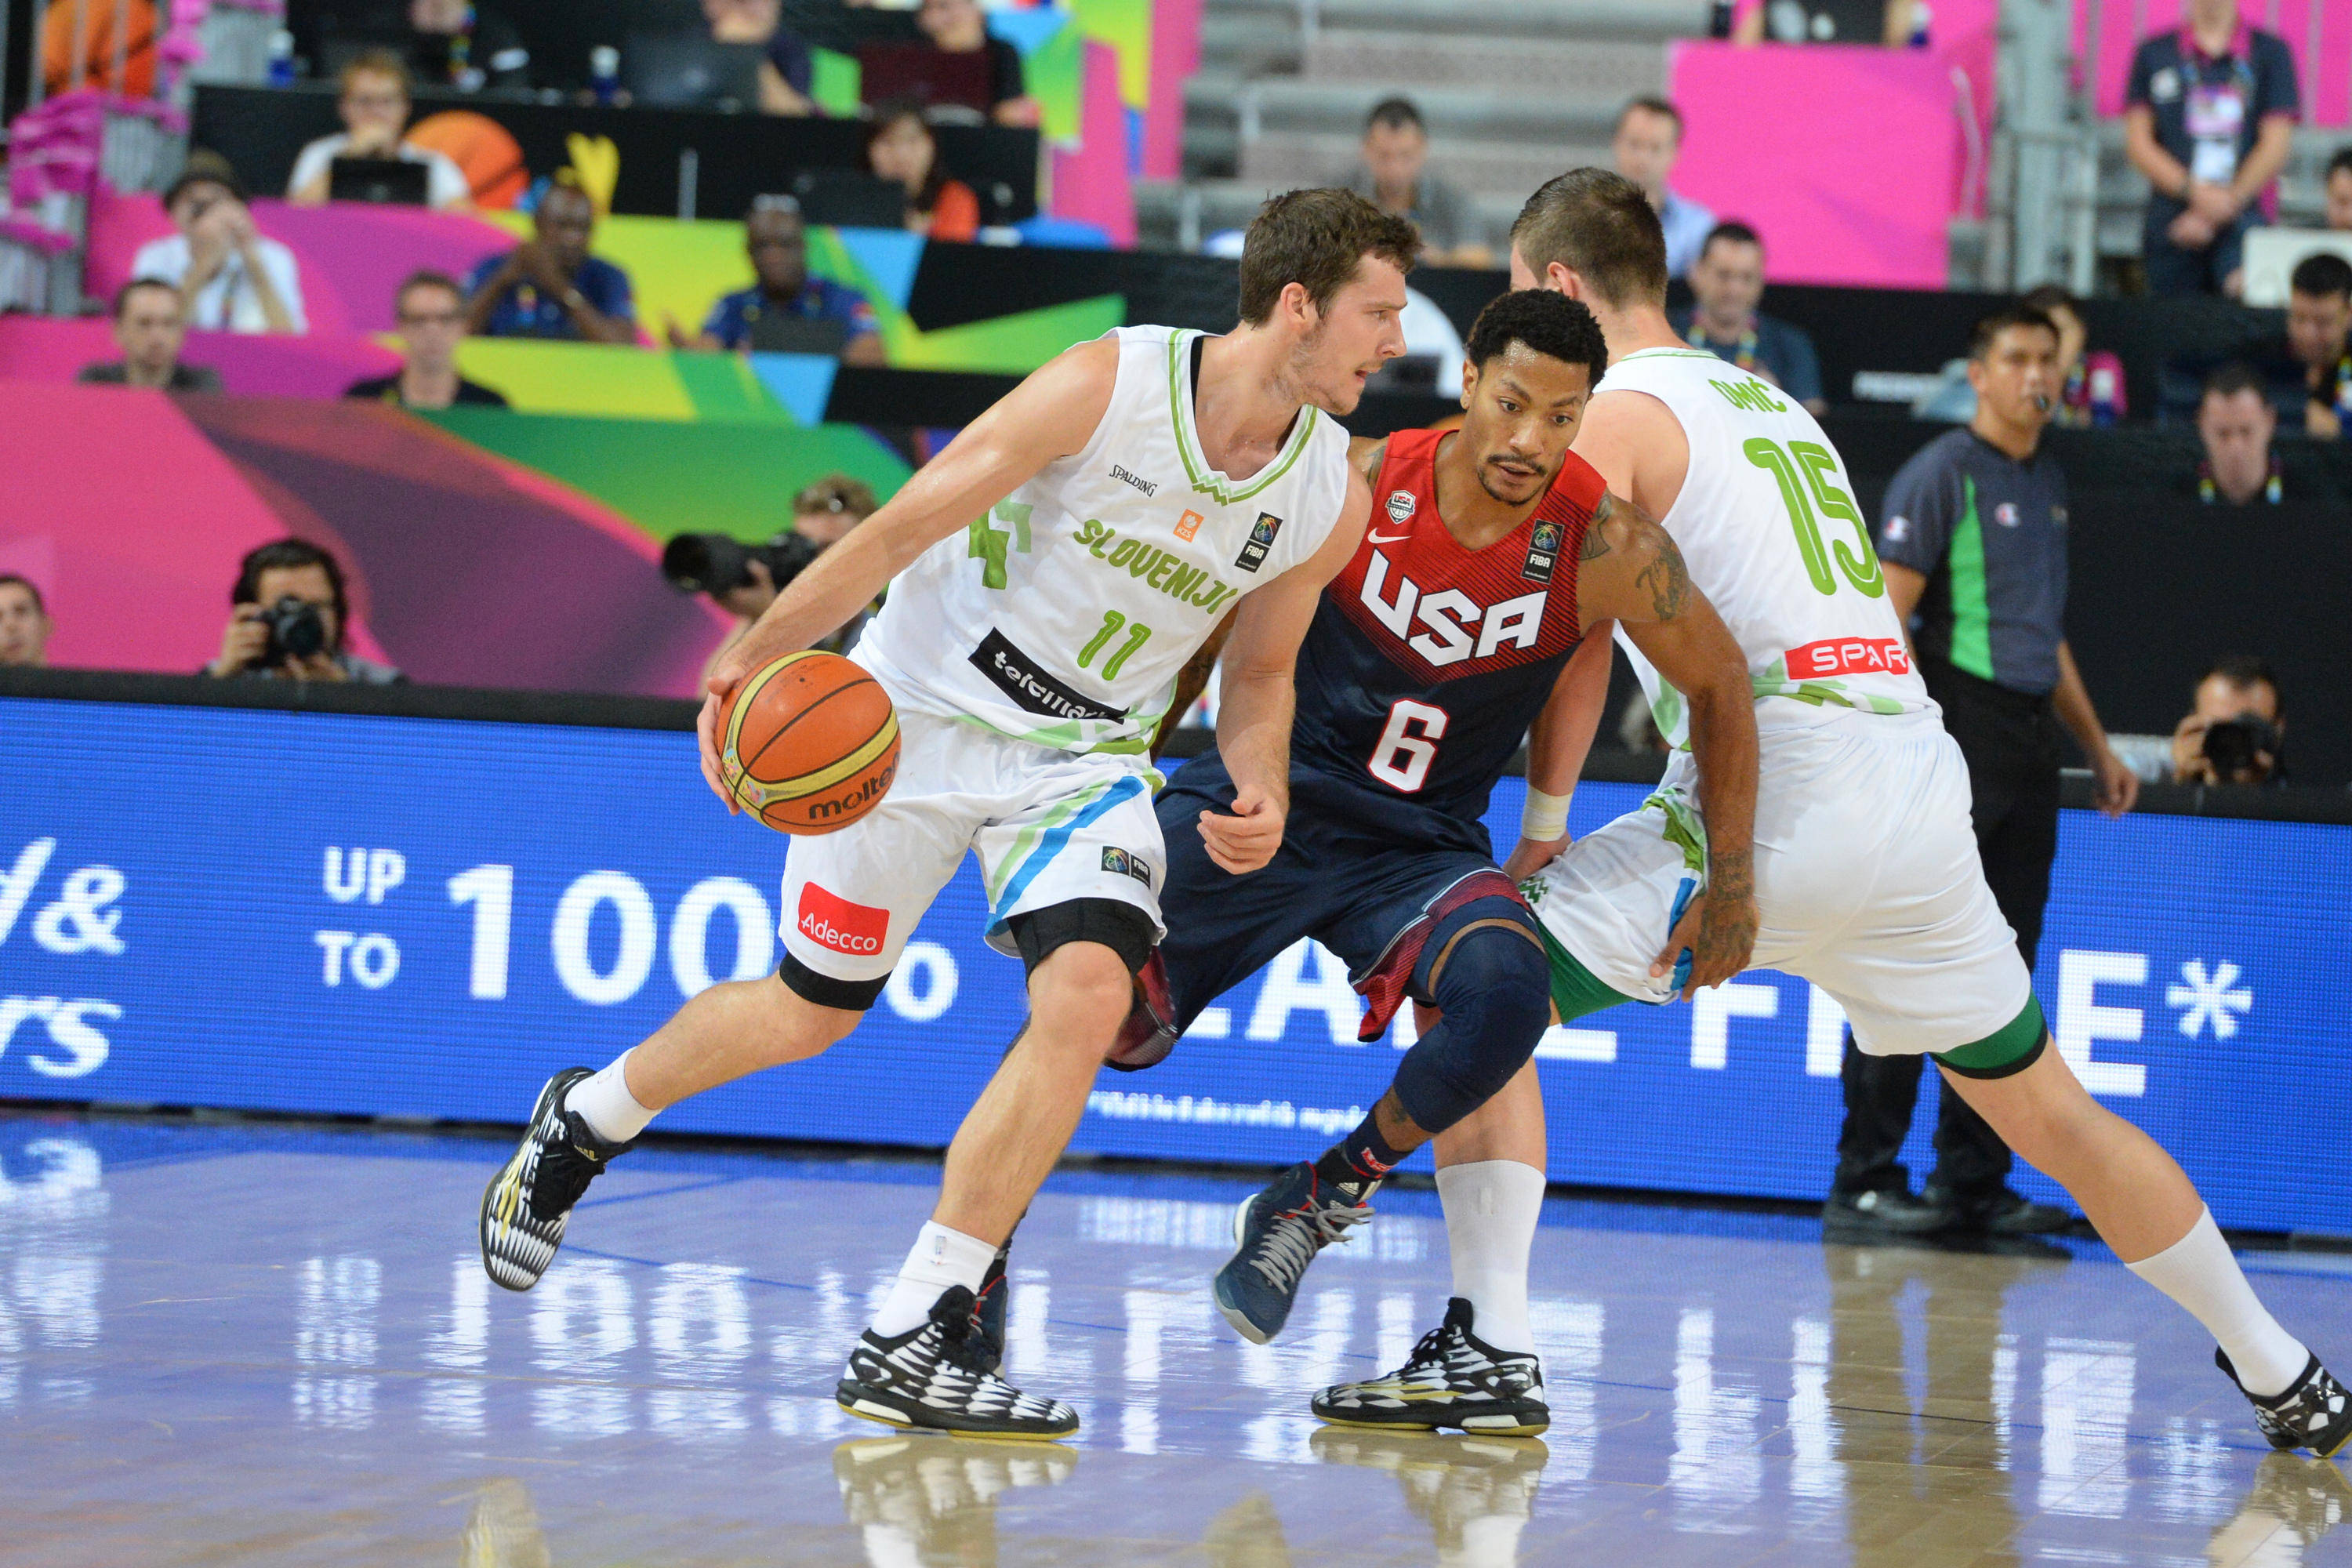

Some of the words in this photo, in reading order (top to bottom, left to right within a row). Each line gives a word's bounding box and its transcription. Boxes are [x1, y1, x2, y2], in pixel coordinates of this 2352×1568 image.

[1109, 465, 1157, 497] SPALDING
[1743, 437, 1884, 598] 15
[1245, 545, 1265, 559] FIBA
[1530, 554, 1551, 568] FIBA
[1360, 548, 1548, 666] USA
[1076, 610, 1151, 681] 11
[1811, 643, 1907, 672] SPAR
[1368, 698, 1450, 793] 6
[323, 847, 406, 904] UP
[1134, 858, 1149, 876] FIBA
[801, 913, 877, 952] Adecco
[315, 930, 400, 989] TO
